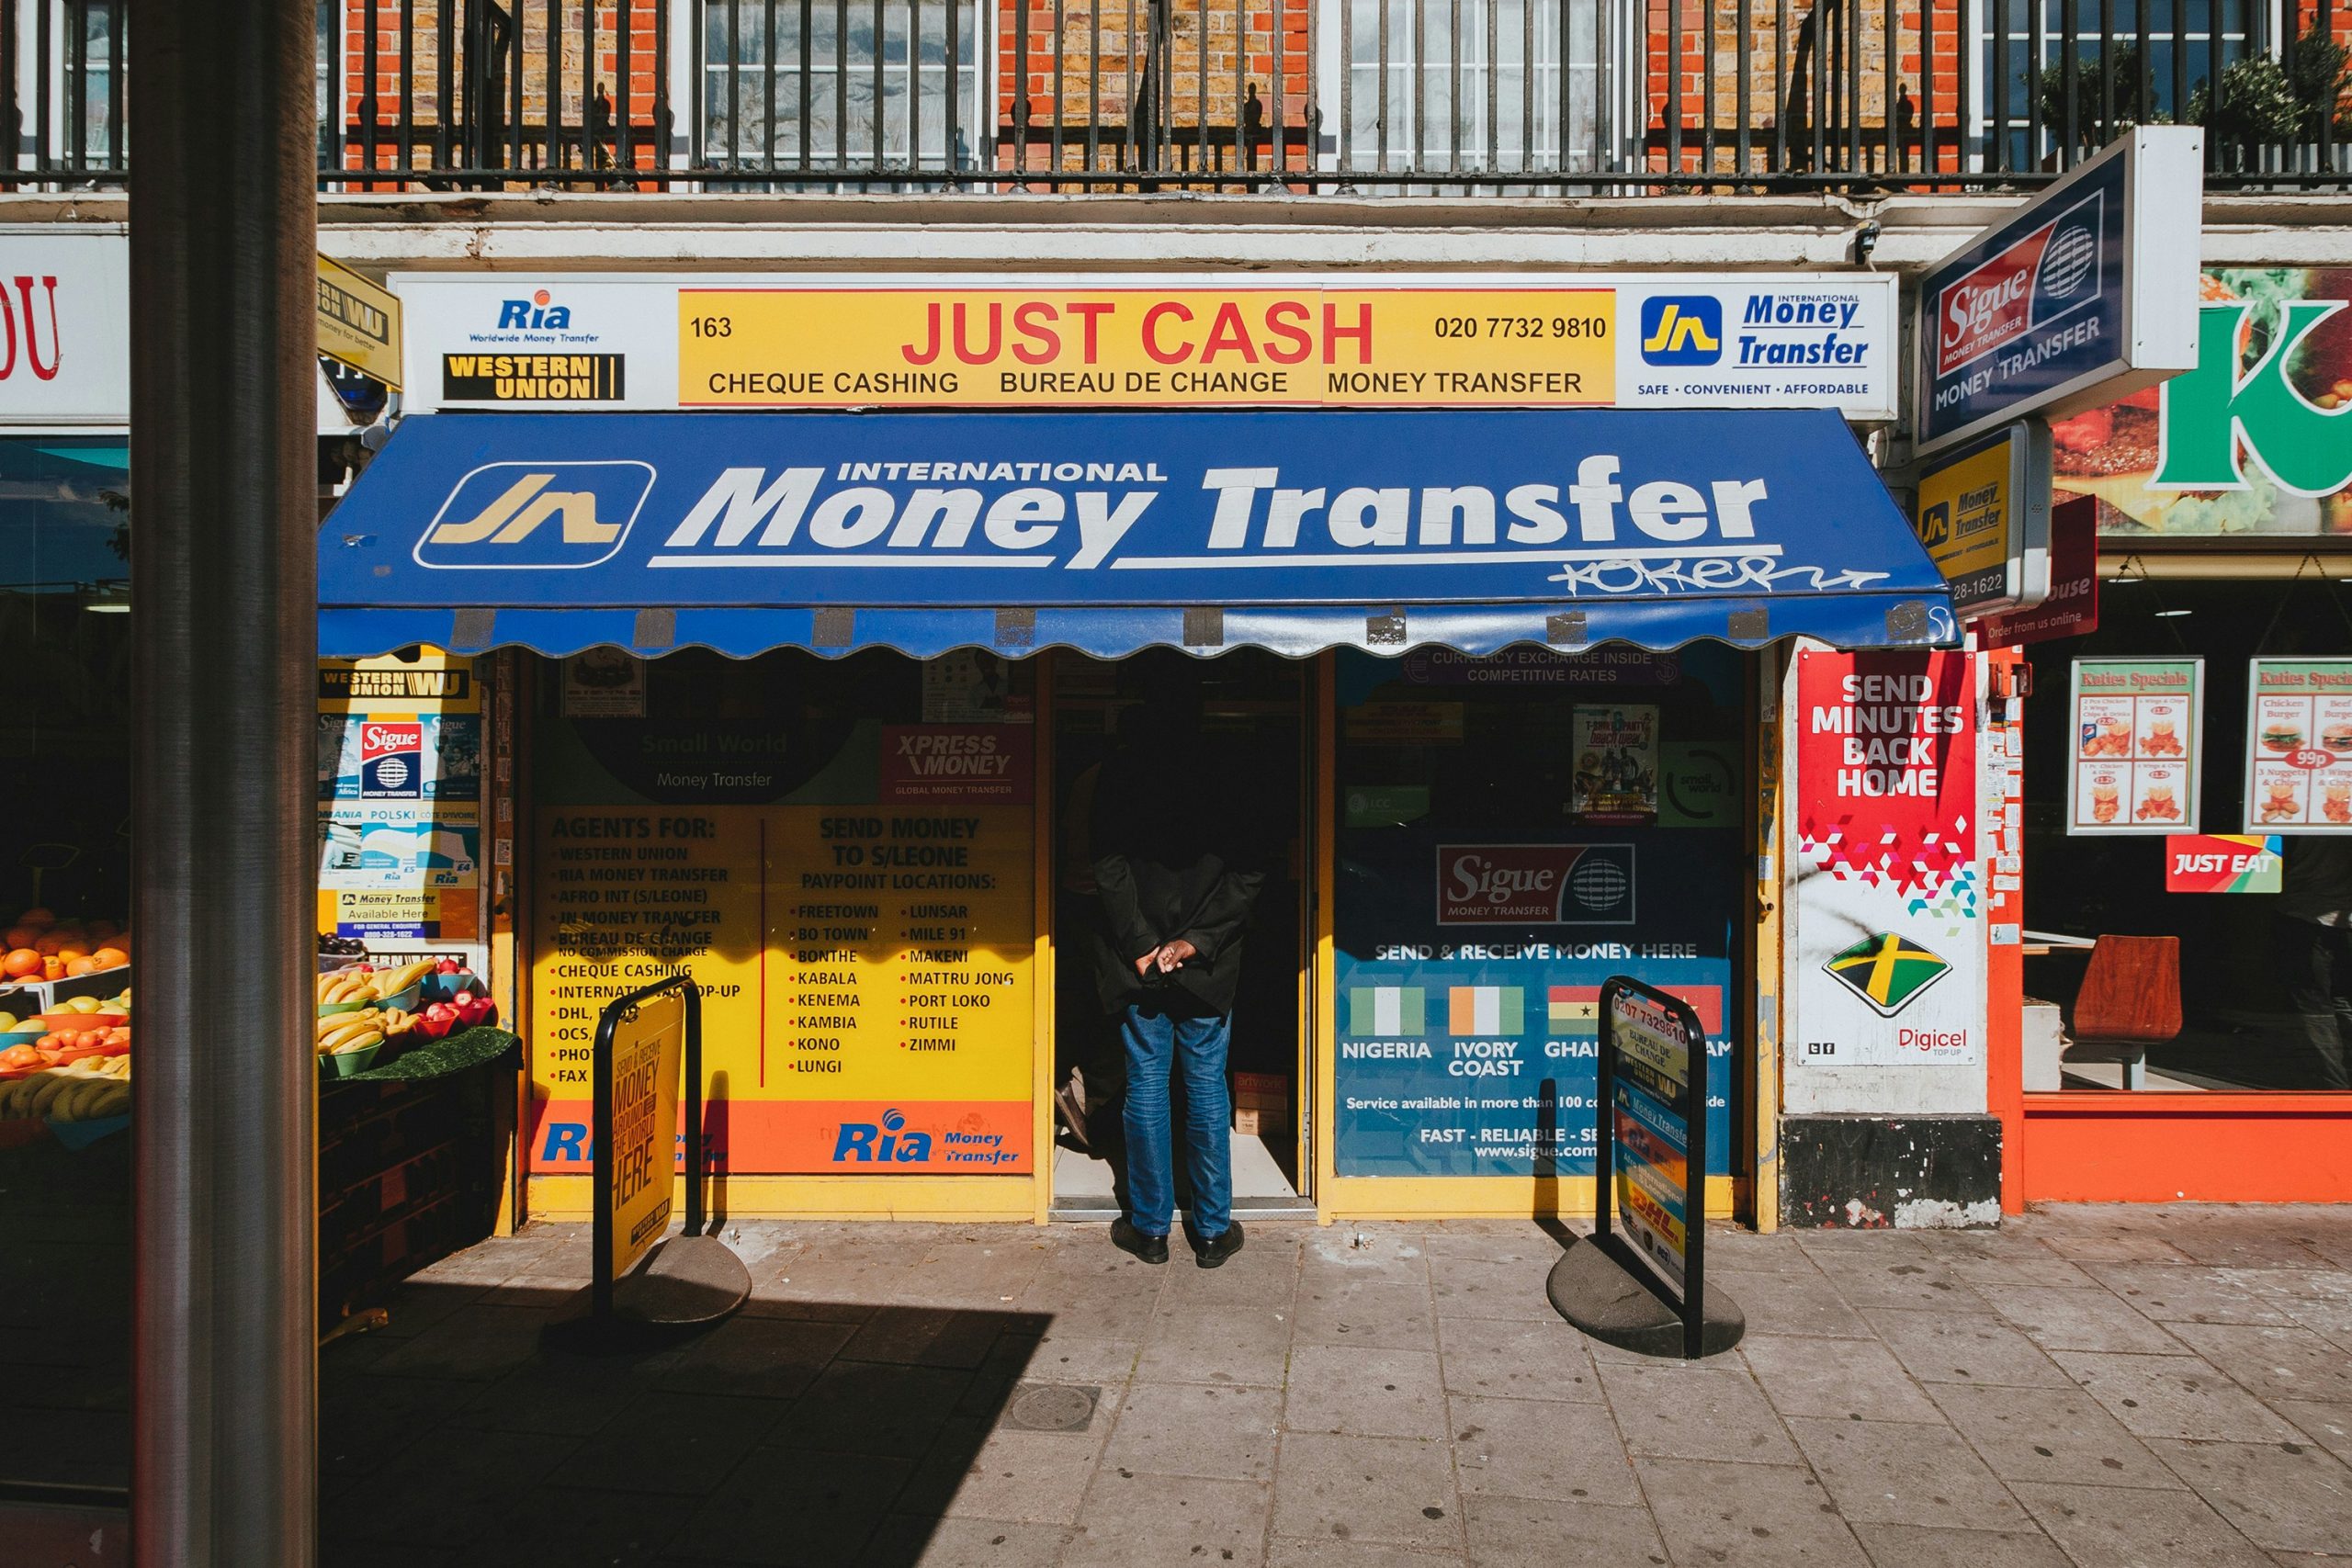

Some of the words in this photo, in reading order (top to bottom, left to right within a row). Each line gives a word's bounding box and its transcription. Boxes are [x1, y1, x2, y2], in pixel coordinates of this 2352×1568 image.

[1778, 295, 1860, 303] INTERNATIONAL
[497, 289, 572, 330] Ria
[1743, 296, 1860, 330] Money
[1945, 268, 2030, 348] Sigue
[691, 317, 731, 338] 163
[901, 300, 1115, 367] JUST
[1141, 300, 1373, 367] CASH
[1434, 318, 1477, 338] 020
[1487, 318, 1544, 338] 7732
[1552, 317, 1606, 338] 9810
[469, 333, 519, 349] Worldwide
[522, 333, 557, 351] Money
[560, 333, 601, 350] Transfer
[1738, 333, 1870, 366] Transfer
[1944, 345, 1974, 367] MONEY
[1974, 316, 2022, 349] TRANSFER
[448, 356, 591, 378] WESTERN
[1935, 367, 1995, 412] MONEY
[1998, 315, 2099, 380] TRANSFER
[496, 378, 591, 400] UNION
[708, 373, 824, 395] CHEQUE
[833, 372, 958, 394] CASHING
[1000, 372, 1115, 393] BUREAU
[1125, 372, 1161, 393] DE
[1170, 371, 1287, 393] CHANGE
[1328, 372, 1426, 393] MONEY
[1434, 371, 1582, 393] TRANSFER
[1638, 384, 1669, 395] SAFE
[1683, 384, 1771, 395] CONVENIENT
[1784, 384, 1870, 395] AFFORDABLE
[837, 460, 1168, 482] INTERNATIONAL
[1203, 454, 1770, 549] Transfer
[1958, 485, 1998, 512] Money
[664, 467, 1159, 570] Money
[1955, 508, 2002, 537] Transfer
[1988, 625, 2012, 639] Order
[2014, 621, 2036, 635] from
[2051, 610, 2083, 627] online
[1603, 652, 1653, 664] INSIDE
[324, 671, 405, 684] WESTERN
[413, 671, 460, 696] WU
[1467, 669, 1566, 682] COMPETITIVE
[1569, 669, 1617, 682] RATES
[2081, 672, 2127, 688] Katies
[2130, 671, 2188, 691] Specials
[2260, 671, 2306, 687] Katies
[350, 684, 405, 696] UNION
[1841, 673, 1934, 704] SEND
[2263, 699, 2305, 707] Chicken
[1811, 705, 1964, 735] MINUTES
[2267, 710, 2301, 720] Burger
[429, 716, 467, 733] Sigue
[364, 726, 419, 751] Sigue
[642, 733, 707, 754] Small
[717, 733, 787, 754] World
[896, 735, 999, 755] XPRESS
[1842, 737, 1934, 766] BACK
[2297, 751, 2327, 767] 99p
[915, 755, 1012, 776] MONEY
[2267, 768, 2308, 779] Nuggets
[656, 772, 708, 790] Money
[712, 772, 774, 787] Transfer
[1838, 768, 1939, 797] HOME
[895, 786, 930, 795] GLOBAL
[931, 786, 964, 795] MONEY
[964, 785, 1013, 795] TRANSFER
[371, 810, 415, 820] POLSKI
[552, 818, 650, 839] AGENTS
[659, 818, 716, 839] FOR:
[820, 817, 883, 840] SEND
[891, 817, 981, 840] MONEY
[560, 848, 632, 861] WESTERN
[638, 848, 687, 861] UNION
[831, 845, 864, 866] TO
[872, 845, 968, 869] S/LEONE
[2172, 853, 2229, 875] JUST
[2230, 854, 2275, 874] EAT
[435, 871, 458, 884] Ria
[559, 867, 584, 882] RIA
[589, 868, 644, 882] MONEY
[650, 868, 729, 882] TRANSFER
[801, 874, 888, 889] PAYPOINT
[892, 874, 997, 890] LOCATIONS:
[1446, 854, 1555, 904] Sigue
[359, 894, 392, 905] Money
[395, 894, 436, 905] Transfer
[558, 888, 600, 904] AFRO
[605, 889, 630, 904] INT
[633, 888, 707, 905] (S/LEONE)
[348, 908, 399, 919] Available
[401, 908, 428, 919] Here
[582, 910, 638, 925] MONEY
[798, 905, 878, 919] FREETOWN
[910, 905, 968, 919] LUNSAR
[1448, 906, 1490, 917] MONEY
[1493, 905, 1550, 916] TRANSFER
[558, 931, 619, 945] BUREAU
[626, 931, 645, 944] DE
[649, 931, 713, 944] CHANGE
[798, 927, 819, 942] BO
[822, 927, 869, 942] TOWN
[910, 927, 945, 942] MILE
[950, 927, 967, 942] 91
[559, 947, 576, 957] NO
[579, 946, 658, 957] COMMISSION
[661, 946, 708, 957] CHARGE
[797, 950, 857, 964] BONTHE
[910, 950, 969, 964] MAKENI
[1374, 944, 1433, 960] SEND
[1440, 944, 1454, 960] &
[1461, 943, 1550, 960] RECEIVE
[1555, 942, 1635, 960] MONEY
[1642, 942, 1698, 959] HERE
[558, 964, 619, 978] CHEQUE
[624, 964, 692, 977] CASHING
[797, 972, 857, 986] KABALA
[910, 972, 970, 986] MATTRU
[975, 972, 1014, 987] JONG
[797, 994, 861, 1007] KENEMA
[910, 994, 947, 1008] PORT
[953, 994, 991, 1008] LOKO
[558, 1007, 593, 1021] DHL,
[1614, 998, 1638, 1020] 0207
[797, 1016, 857, 1030] KAMBIA
[910, 1017, 959, 1030] RUTILE
[558, 1027, 593, 1042] OCS,
[1629, 1028, 1658, 1053] BUREAU
[1899, 1029, 1967, 1052] Digicel
[797, 1038, 841, 1051] KONO
[910, 1038, 956, 1052] ZIMMI
[1342, 1042, 1432, 1058] NIGERIA
[1454, 1041, 1519, 1058] IVORY
[1634, 1043, 1666, 1067] CHANGE
[797, 1060, 842, 1074] LUNGI
[1448, 1060, 1524, 1077] COAST
[558, 1069, 588, 1082] FAX
[1347, 1096, 1398, 1110] Service
[1401, 1096, 1461, 1110] available
[1464, 1096, 1477, 1109] in
[1480, 1098, 1520, 1109] more
[1522, 1096, 1554, 1109] than
[1558, 1096, 1581, 1109] 100
[832, 1108, 933, 1163] Ria
[944, 1132, 1004, 1147] Money
[1420, 1128, 1466, 1143] FAST
[1481, 1128, 1566, 1143] RELIABLE
[946, 1149, 1020, 1166] Transfer
